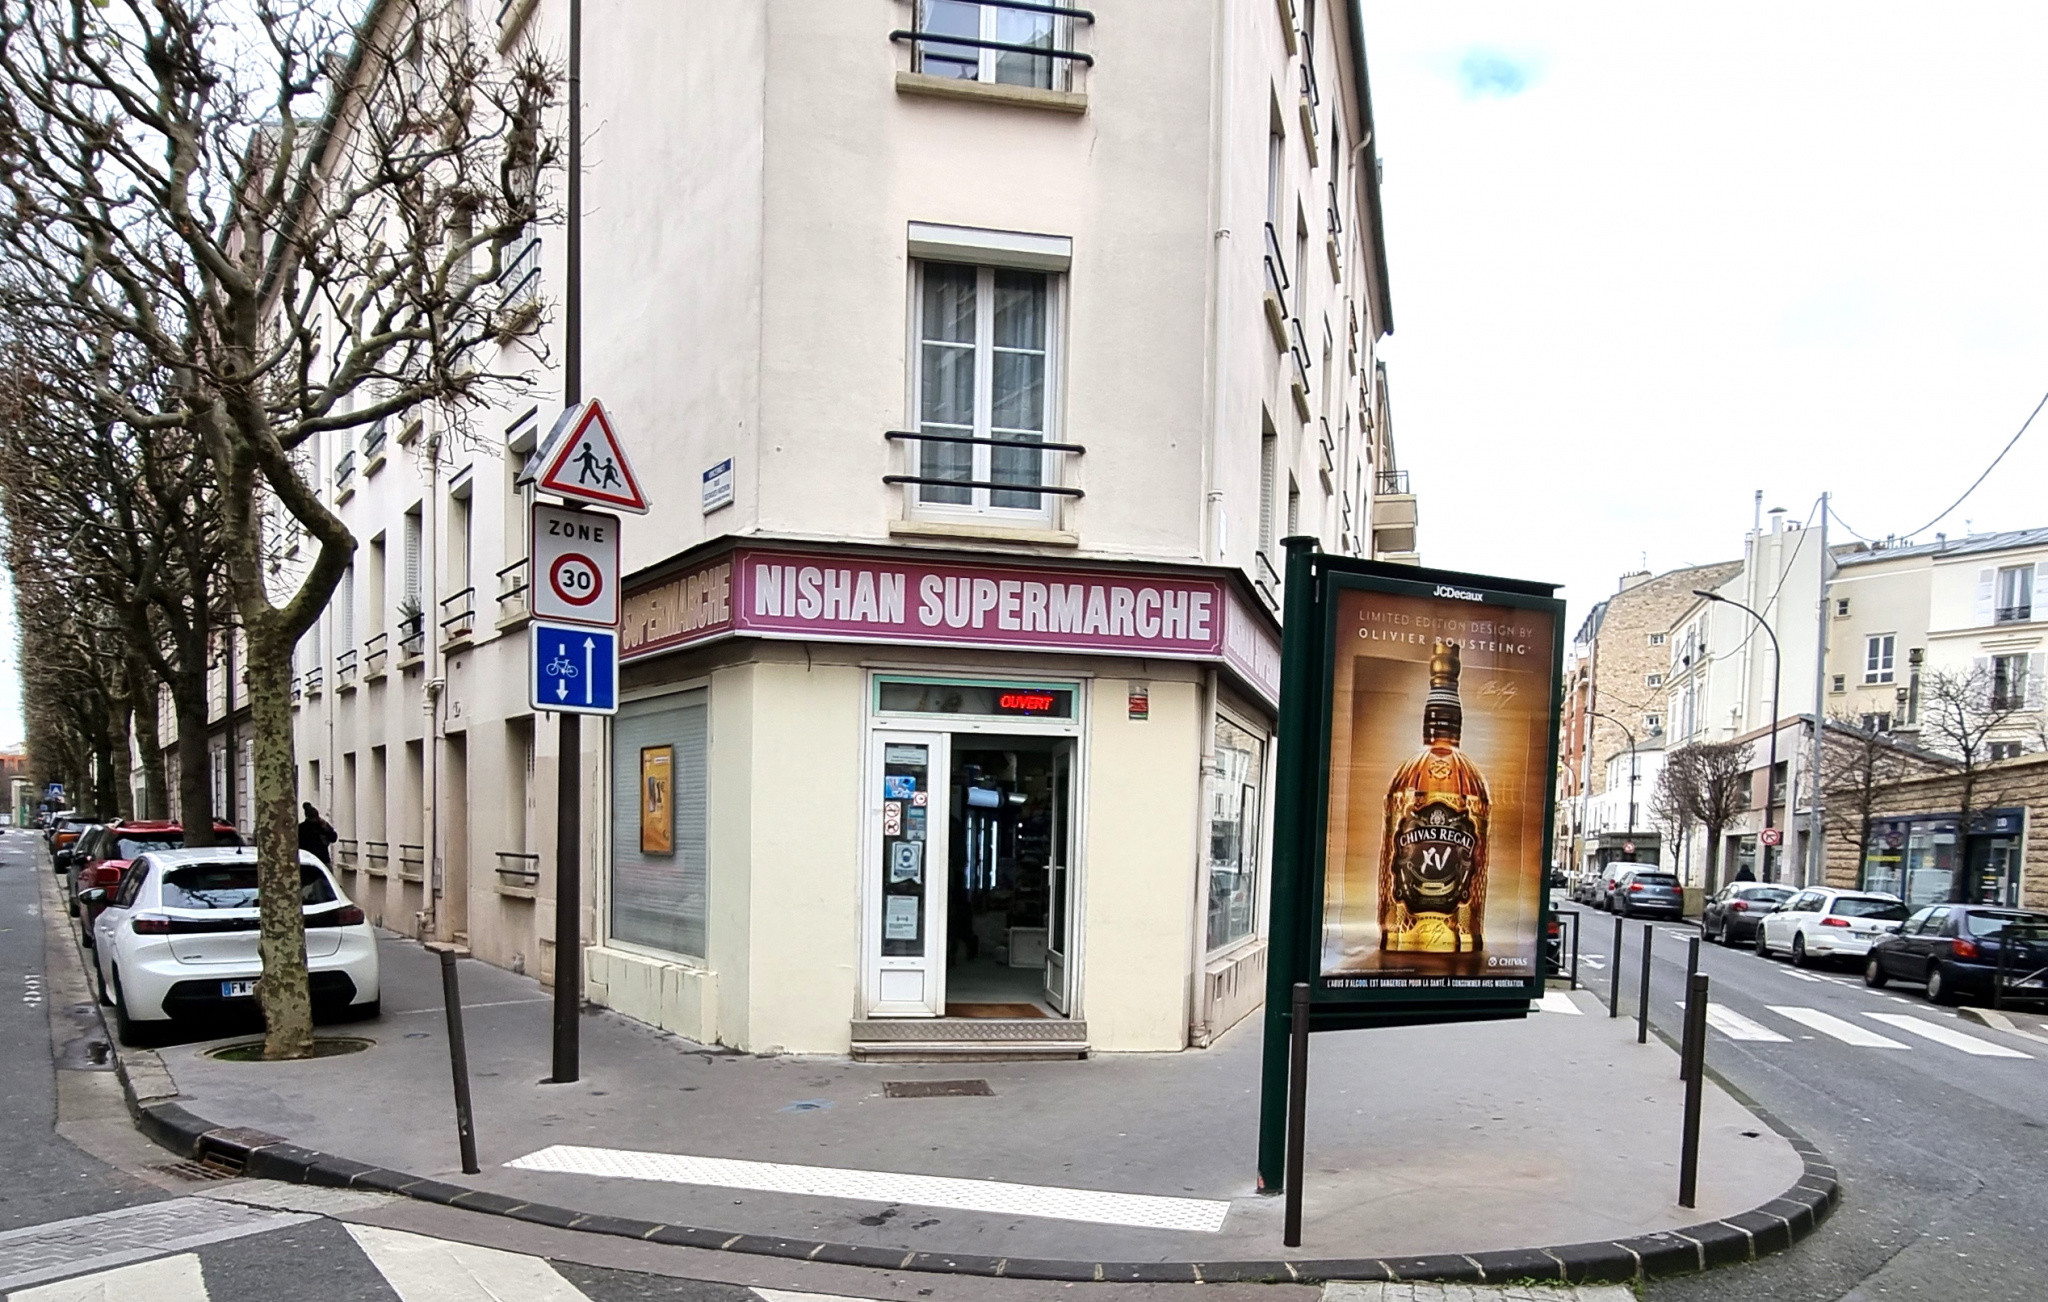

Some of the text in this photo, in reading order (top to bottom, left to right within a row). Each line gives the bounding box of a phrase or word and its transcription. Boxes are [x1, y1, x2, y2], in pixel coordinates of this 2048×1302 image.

[549, 519, 604, 543] ZONE
[562, 569, 591, 590] 30
[755, 564, 1212, 641] NISHAN SUPERMARCHE
[1433, 585, 1484, 602] JCDecaux
[623, 562, 731, 650] SUPERMARCHE
[1359, 610, 1533, 639] LIMITED EDITION DESIGN BY
[1358, 627, 1426, 645] OLIVIER
[1001, 695, 1053, 710] OUVERT
[1400, 828, 1471, 849] CHIVAS REGAL
[1421, 846, 1452, 874] XV
[1499, 957, 1528, 967] CHIVAS
[231, 981, 257, 994] FW-
